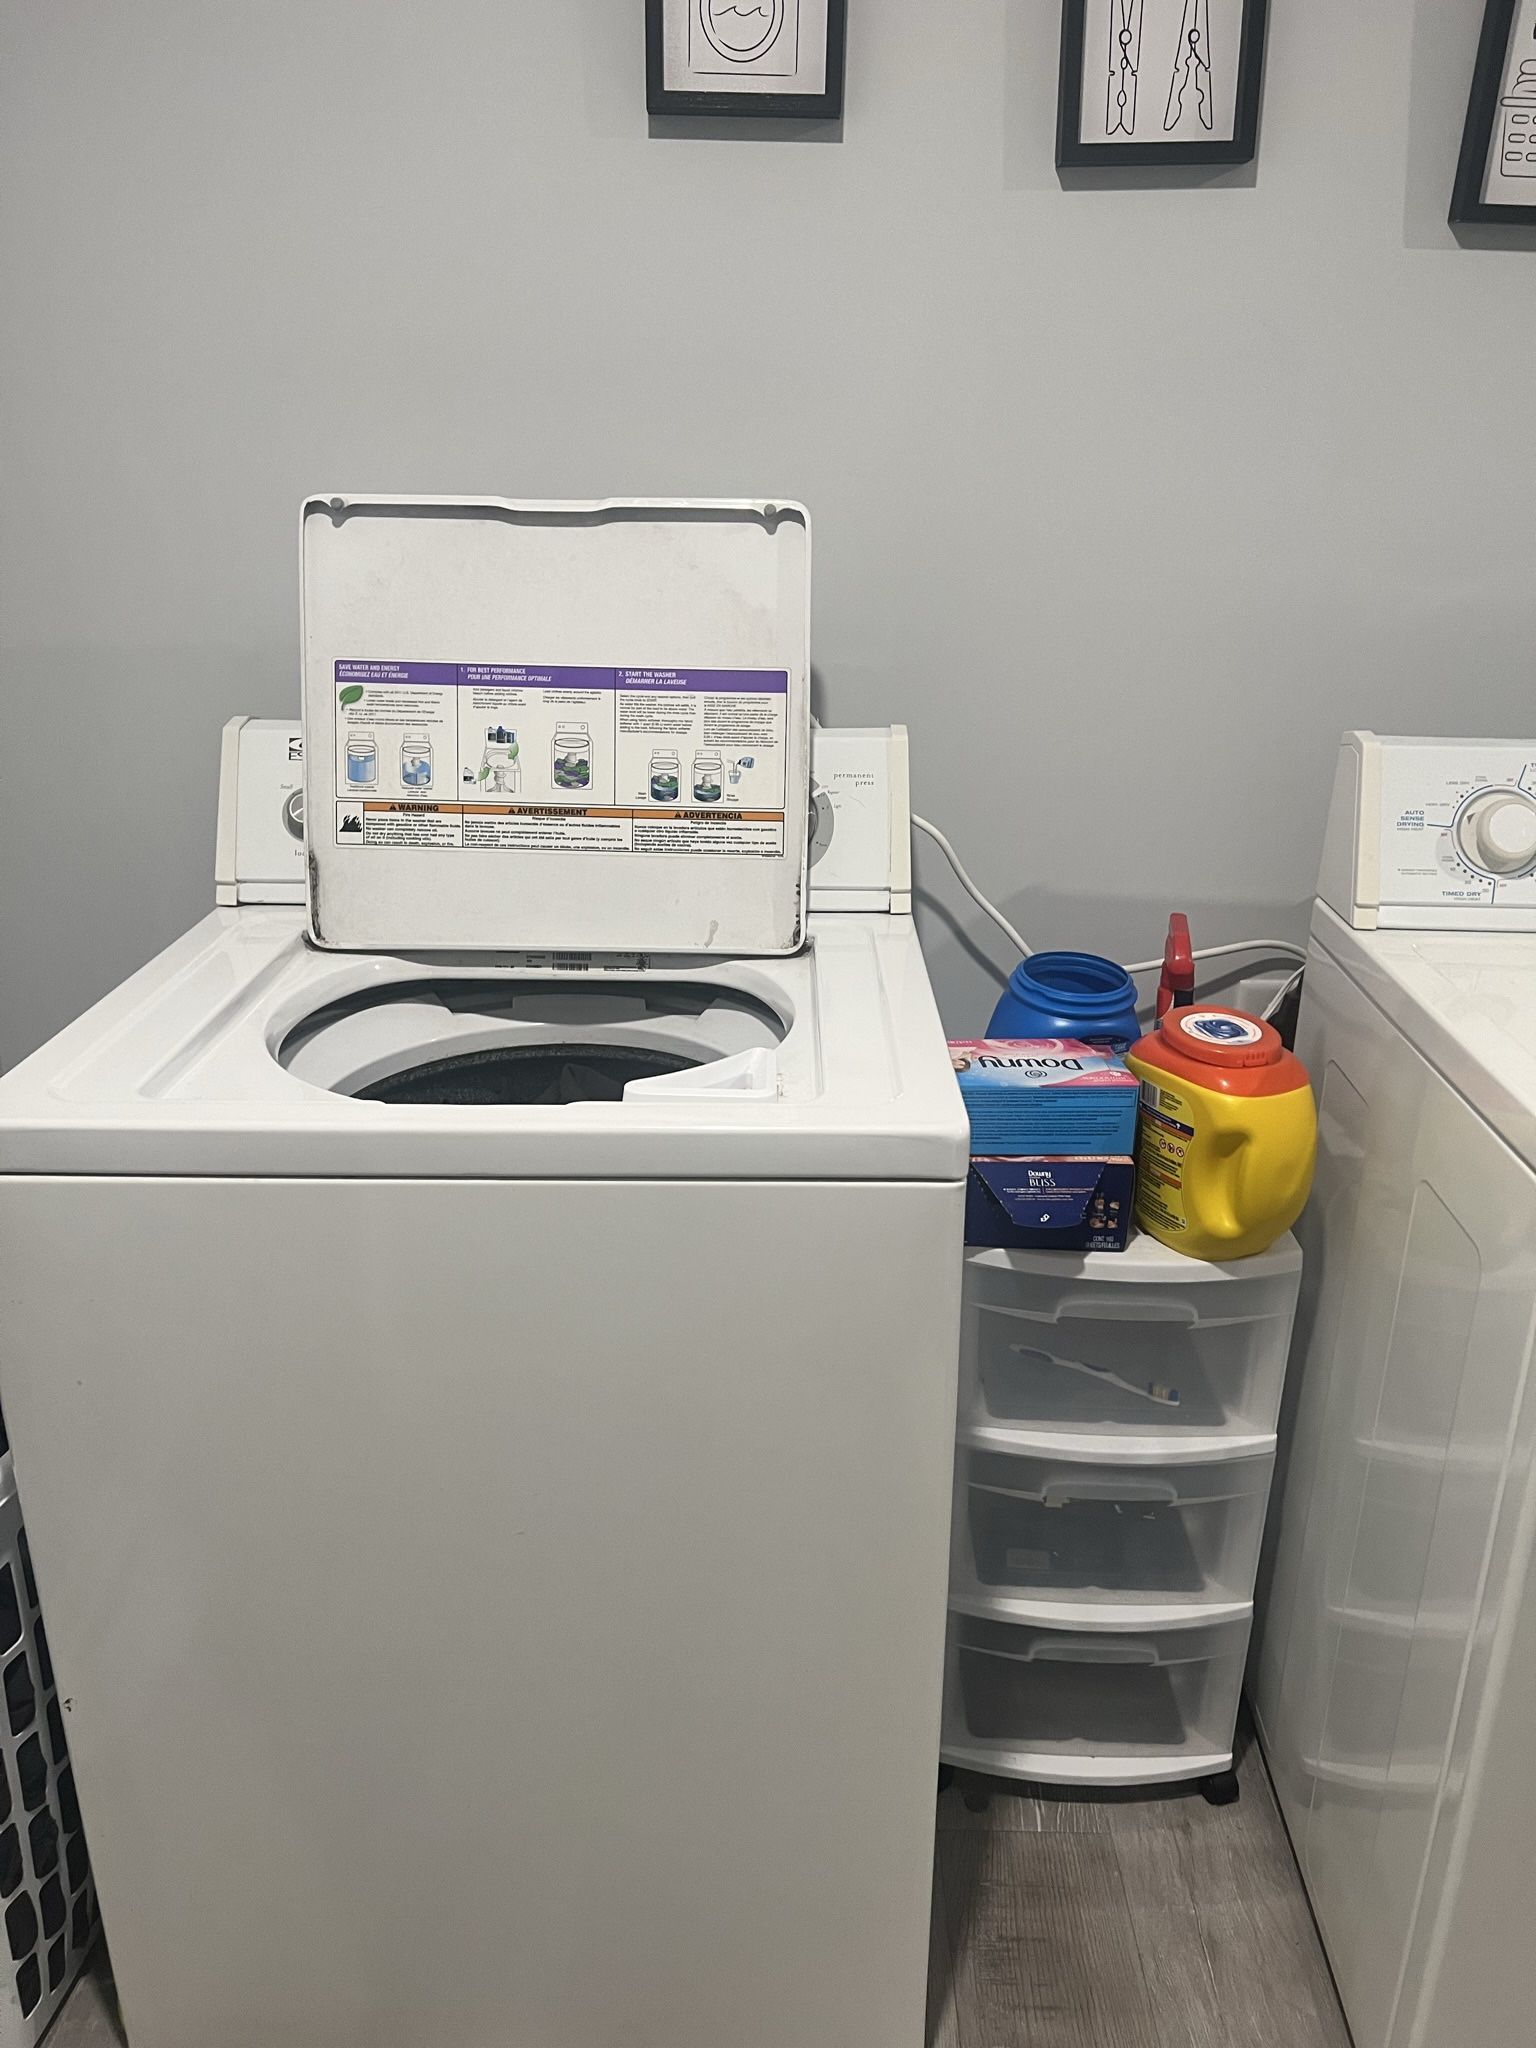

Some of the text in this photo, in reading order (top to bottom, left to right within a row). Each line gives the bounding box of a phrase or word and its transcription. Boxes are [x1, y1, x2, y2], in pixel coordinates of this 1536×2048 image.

[398, 803, 439, 811] WARNING
[517, 807, 588, 816] AVERTISSEMENT
[683, 811, 743, 820] ADVERTENCIA
[977, 1055, 1084, 1071] Downy
[1028, 1170, 1052, 1178] Downy
[1029, 1178, 1056, 1187] BLISS
